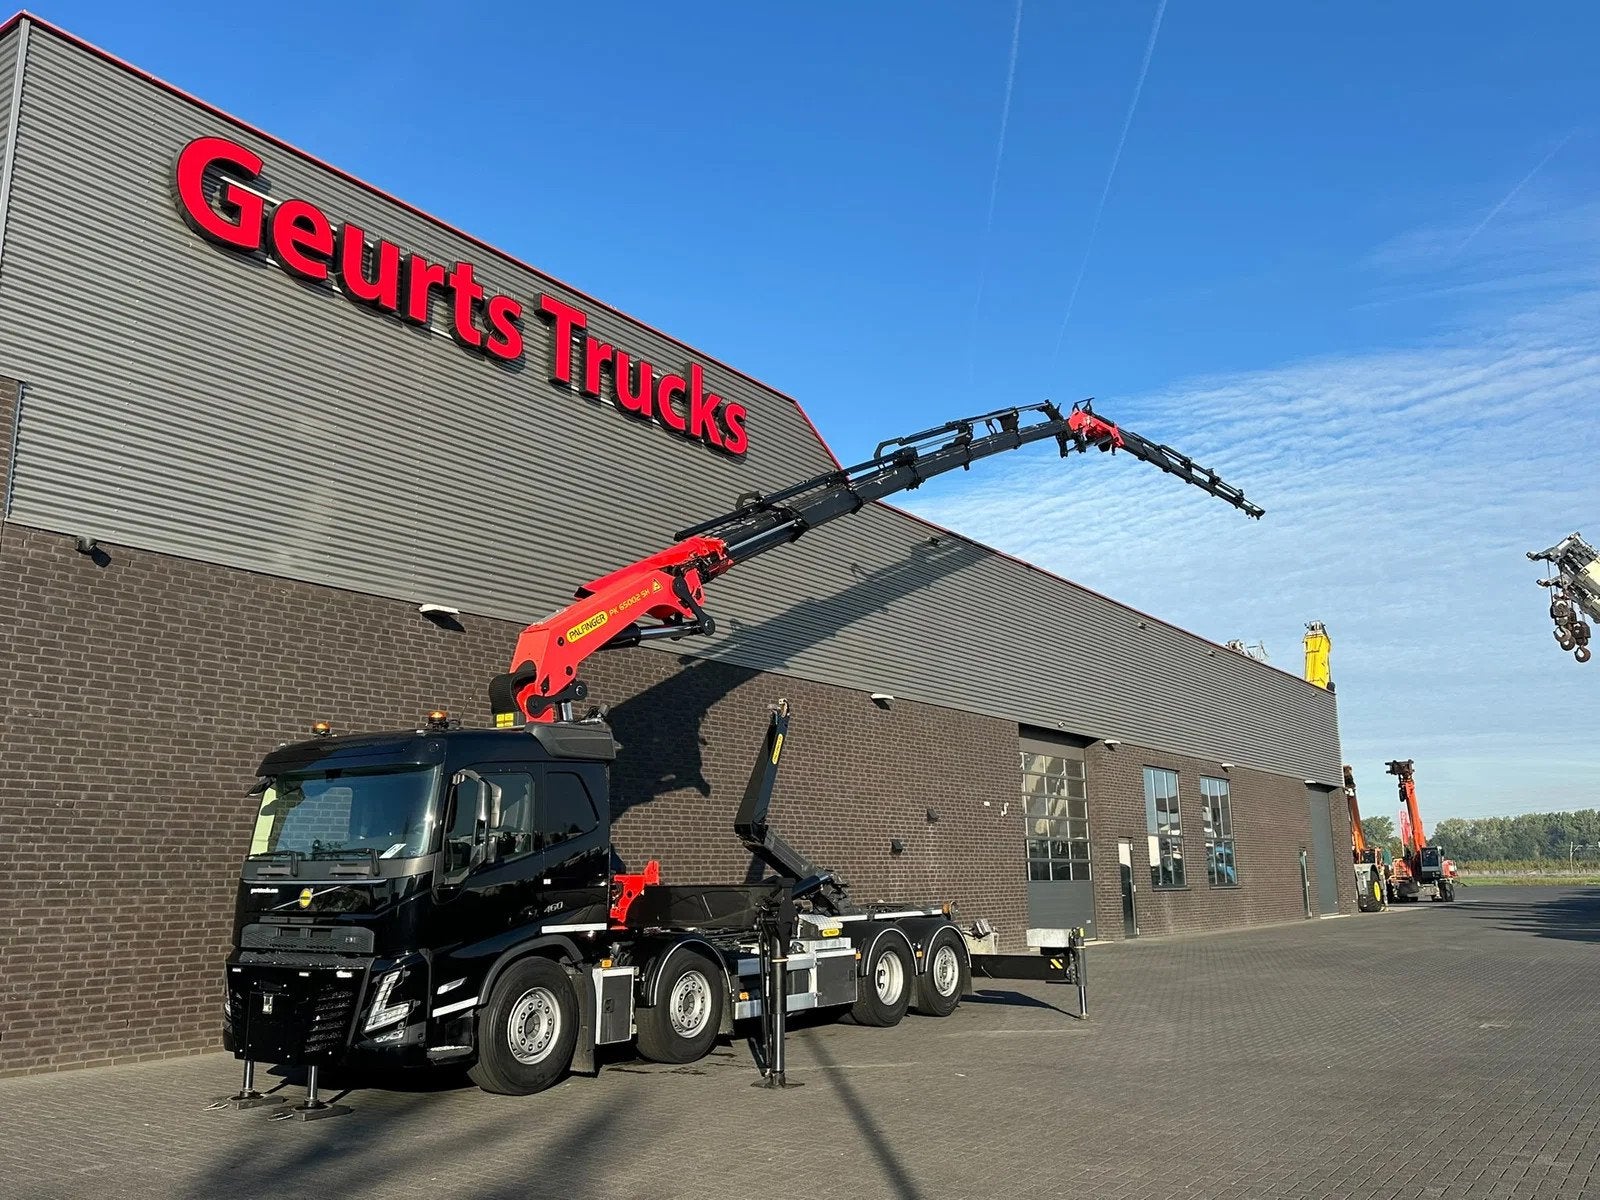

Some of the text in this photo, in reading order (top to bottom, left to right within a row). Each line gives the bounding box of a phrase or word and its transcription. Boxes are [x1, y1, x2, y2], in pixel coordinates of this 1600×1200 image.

[175, 136, 748, 455] Geurts Trucks
[568, 588, 651, 640] PALFINGER PK 65002 SH
[543, 901, 564, 913] 460
